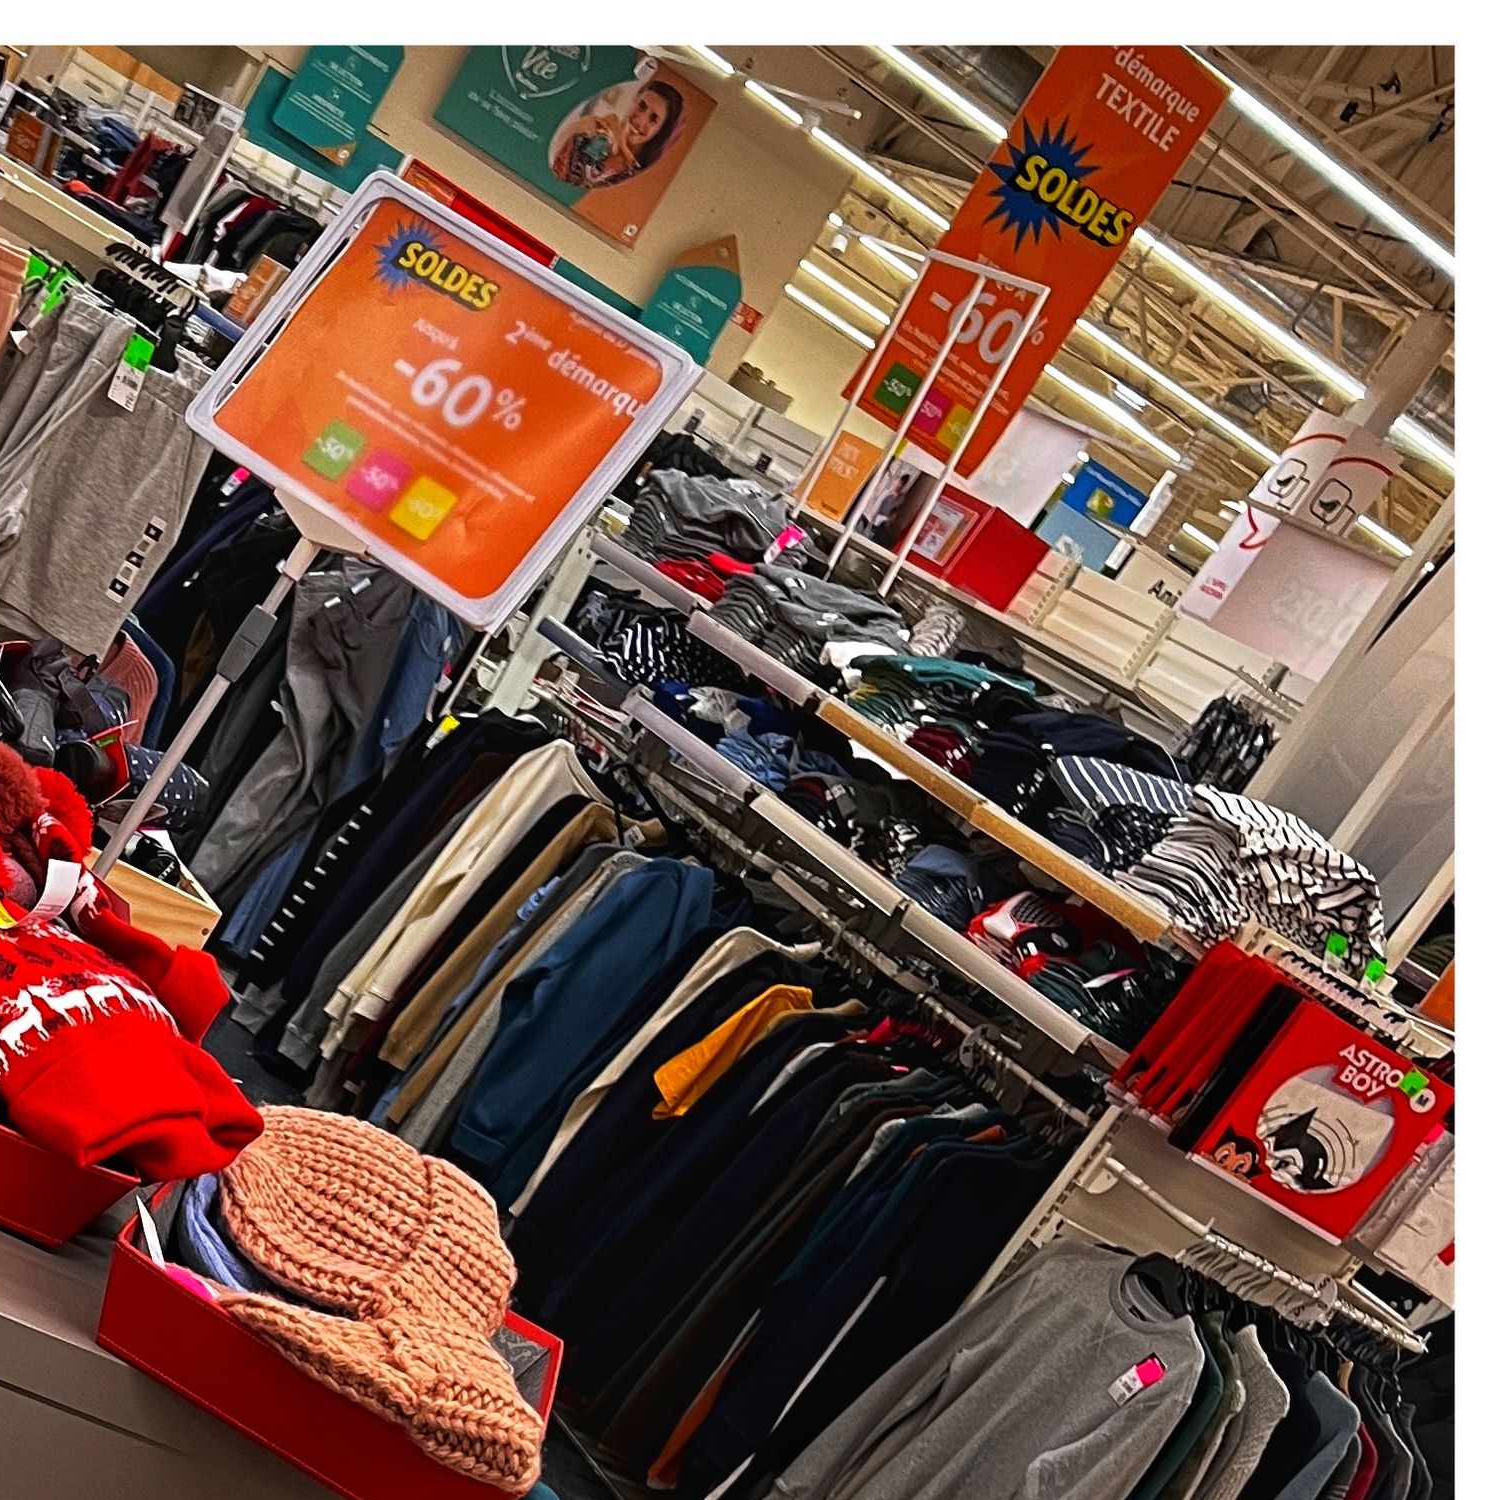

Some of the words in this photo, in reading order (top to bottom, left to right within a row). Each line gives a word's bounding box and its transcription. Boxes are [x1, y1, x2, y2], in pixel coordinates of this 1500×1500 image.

[1095, 72, 1181, 152] TEXTILE
[1114, 48, 1200, 124] démarque
[1015, 154, 1134, 246] SOLDES
[397, 242, 499, 310] SOLDES
[393, 357, 527, 431] -60%
[1339, 1043, 1404, 1088] ASTRO
[1340, 1064, 1385, 1097] BOY
